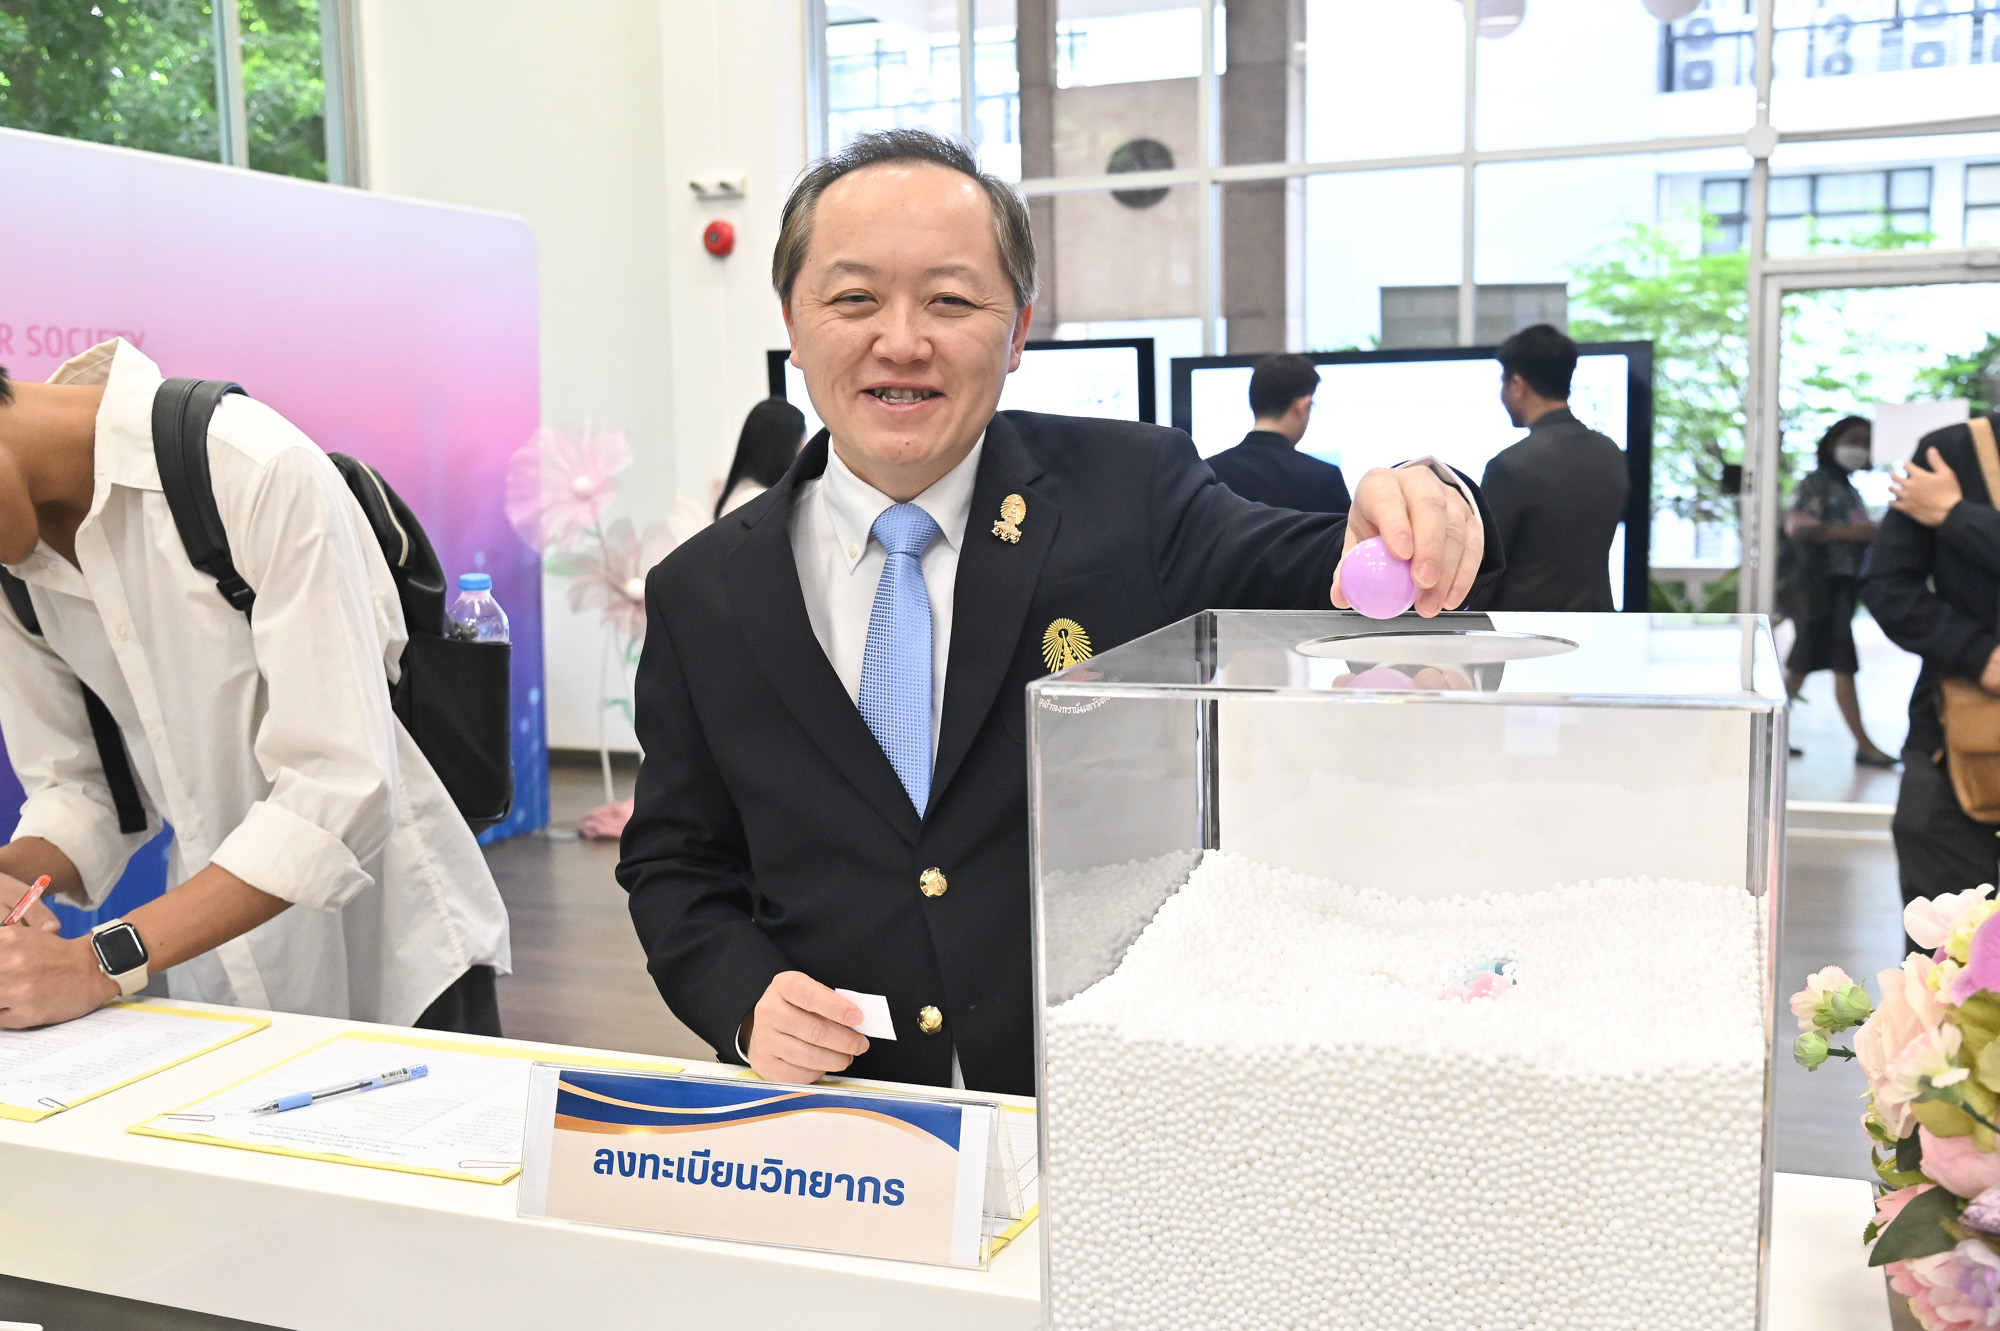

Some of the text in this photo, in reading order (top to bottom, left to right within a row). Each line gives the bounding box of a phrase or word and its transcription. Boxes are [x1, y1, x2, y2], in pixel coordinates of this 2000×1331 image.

[593, 1148, 906, 1207] ลงทะเบียนวิทยากร
